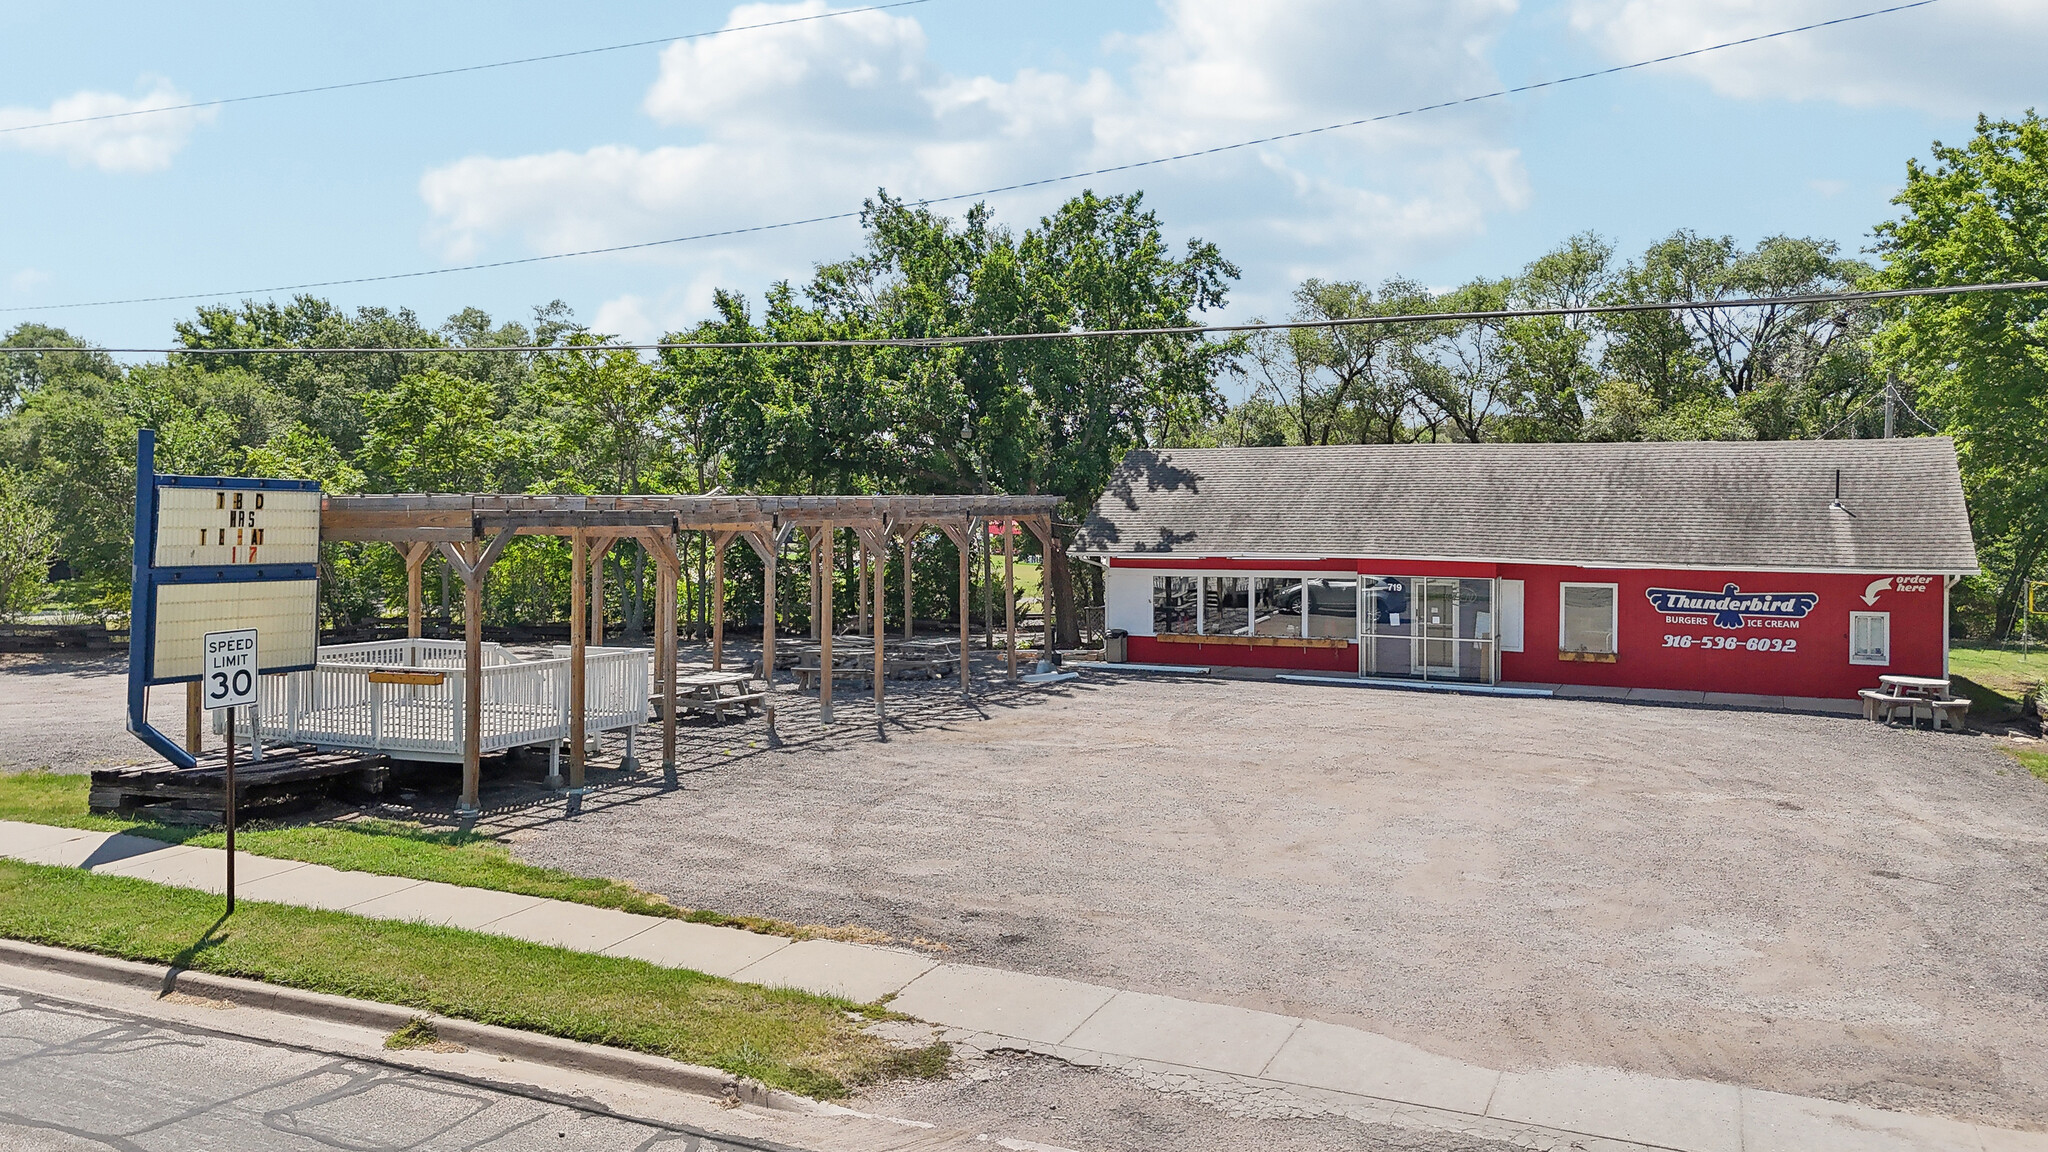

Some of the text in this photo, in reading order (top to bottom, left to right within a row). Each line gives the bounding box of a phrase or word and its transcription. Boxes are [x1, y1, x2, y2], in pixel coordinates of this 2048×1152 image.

[230, 510, 255, 527] HRS
[1895, 575, 1933, 584] order
[1387, 583, 1402, 592] 719
[1896, 583, 1926, 592] here
[1667, 594, 1796, 612] Thunderbird
[1665, 615, 1800, 629] BURGERS ICE CREAM
[209, 638, 253, 653] SPEED
[1662, 634, 1797, 652] 316-536-6032
[214, 654, 248, 668] LIMIT
[210, 669, 252, 699] 30
